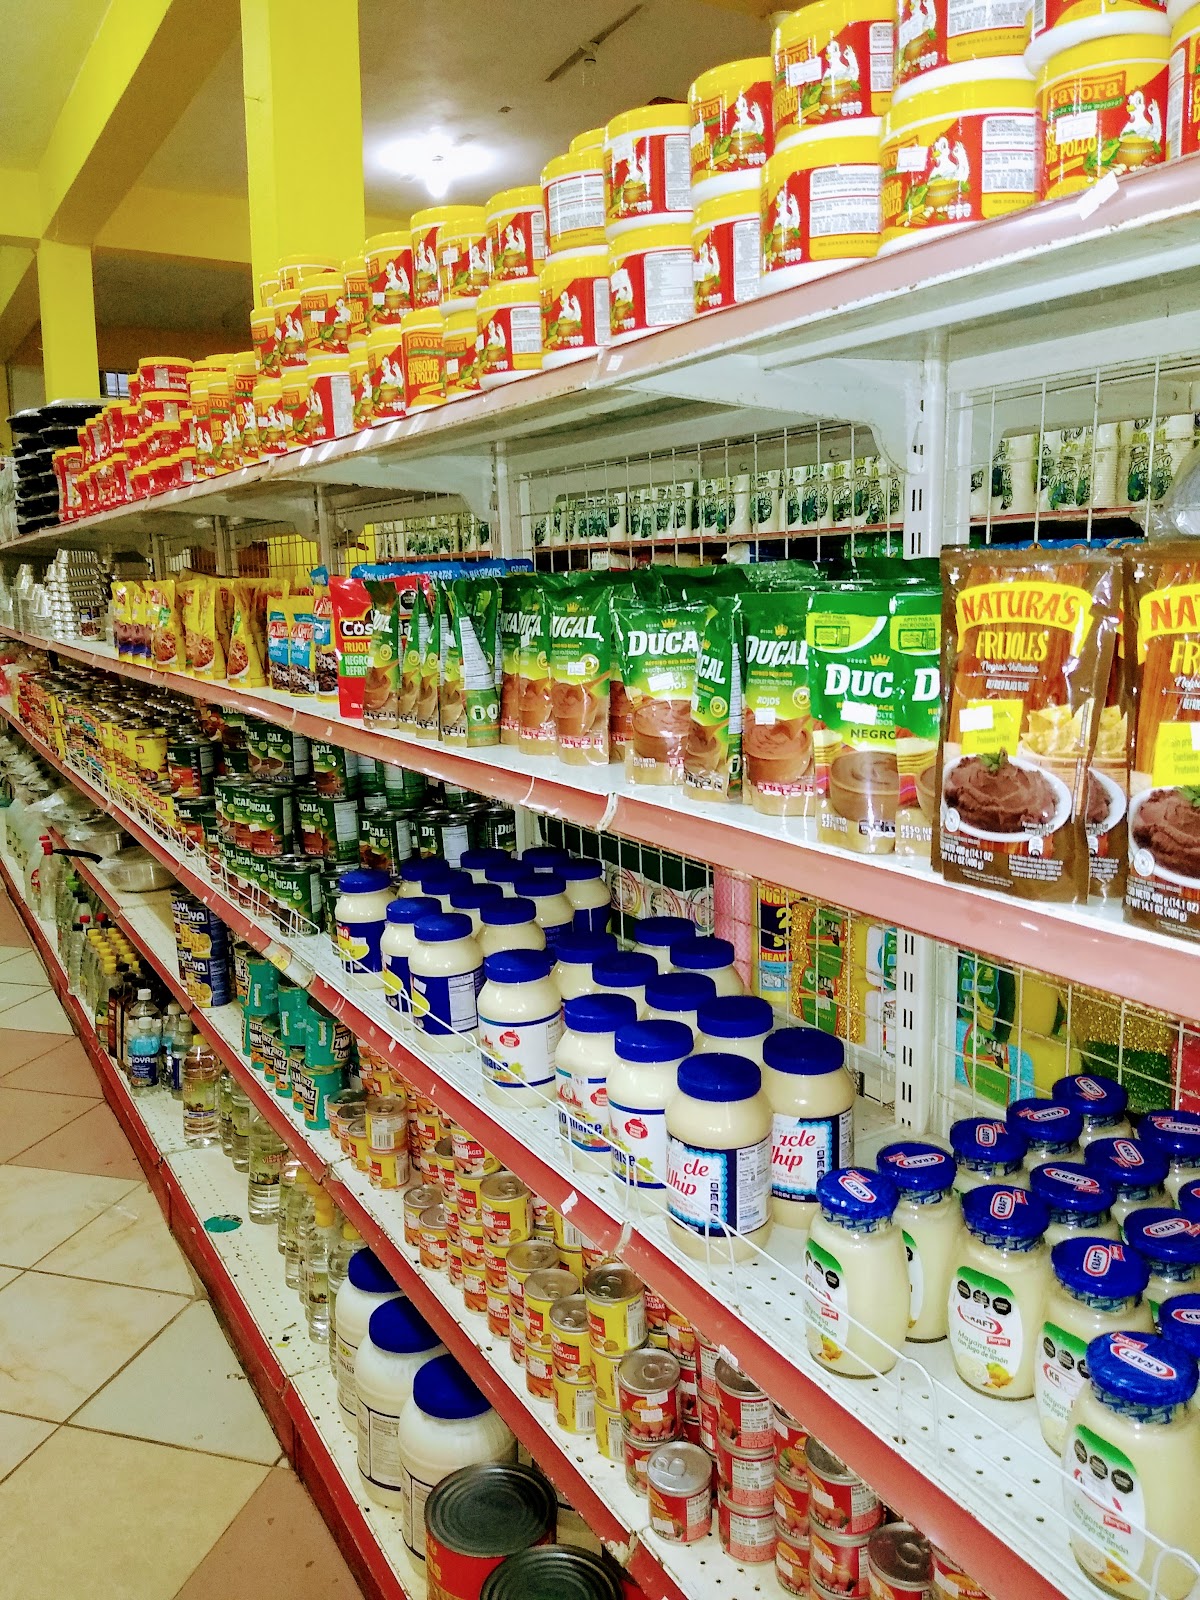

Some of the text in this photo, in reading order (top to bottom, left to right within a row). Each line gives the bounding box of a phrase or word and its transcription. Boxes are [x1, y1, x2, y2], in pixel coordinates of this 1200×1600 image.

[1060, 136, 1098, 159] POLLO
[961, 590, 1079, 624] NATURA'S
[745, 635, 808, 668] DUCAL
[976, 630, 1049, 662] FRIJOLES
[900, 824, 920, 834] PESO
[1135, 888, 1151, 901] NETO
[1151, 892, 1163, 905] 400
[1169, 896, 1185, 911] (14.1
[1186, 902, 1199, 915] OZ)
[1141, 900, 1154, 913] 14.1
[1163, 906, 1179, 920] (400
[1038, 1109, 1062, 1119] KRAFT
[905, 1156, 938, 1166] KRAFT
[1121, 1144, 1138, 1162] KRAFT
[1054, 1171, 1089, 1185] KRAFT
[846, 1180, 869, 1198] KRAFT
[1152, 1221, 1180, 1234] KRAFT
[1090, 1251, 1104, 1271] KRAFT
[957, 1330, 997, 1355] Mayonesa
[1120, 1350, 1168, 1374] KRAFT
